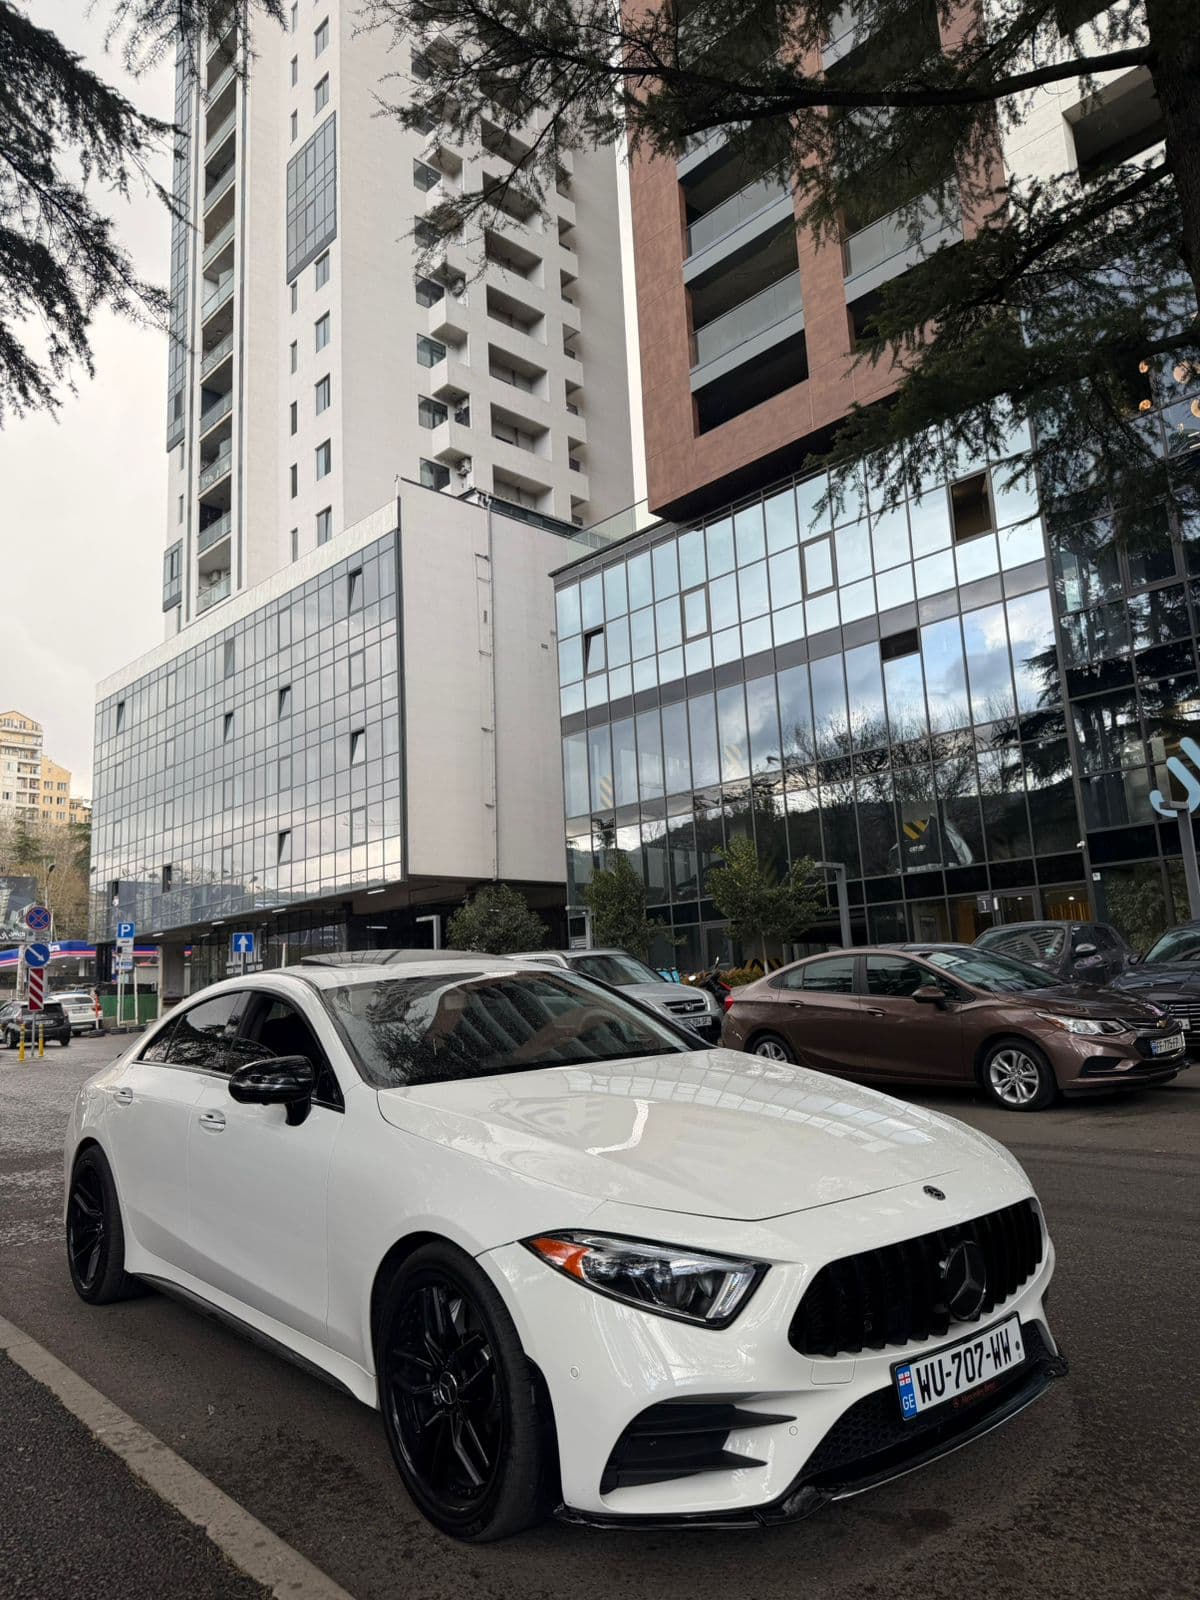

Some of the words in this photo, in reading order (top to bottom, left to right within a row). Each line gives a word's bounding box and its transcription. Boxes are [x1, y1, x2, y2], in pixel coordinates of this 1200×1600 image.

[120, 924, 131, 937] P
[916, 1328, 1012, 1404] WU-707-WW
[902, 1393, 916, 1411] GE
